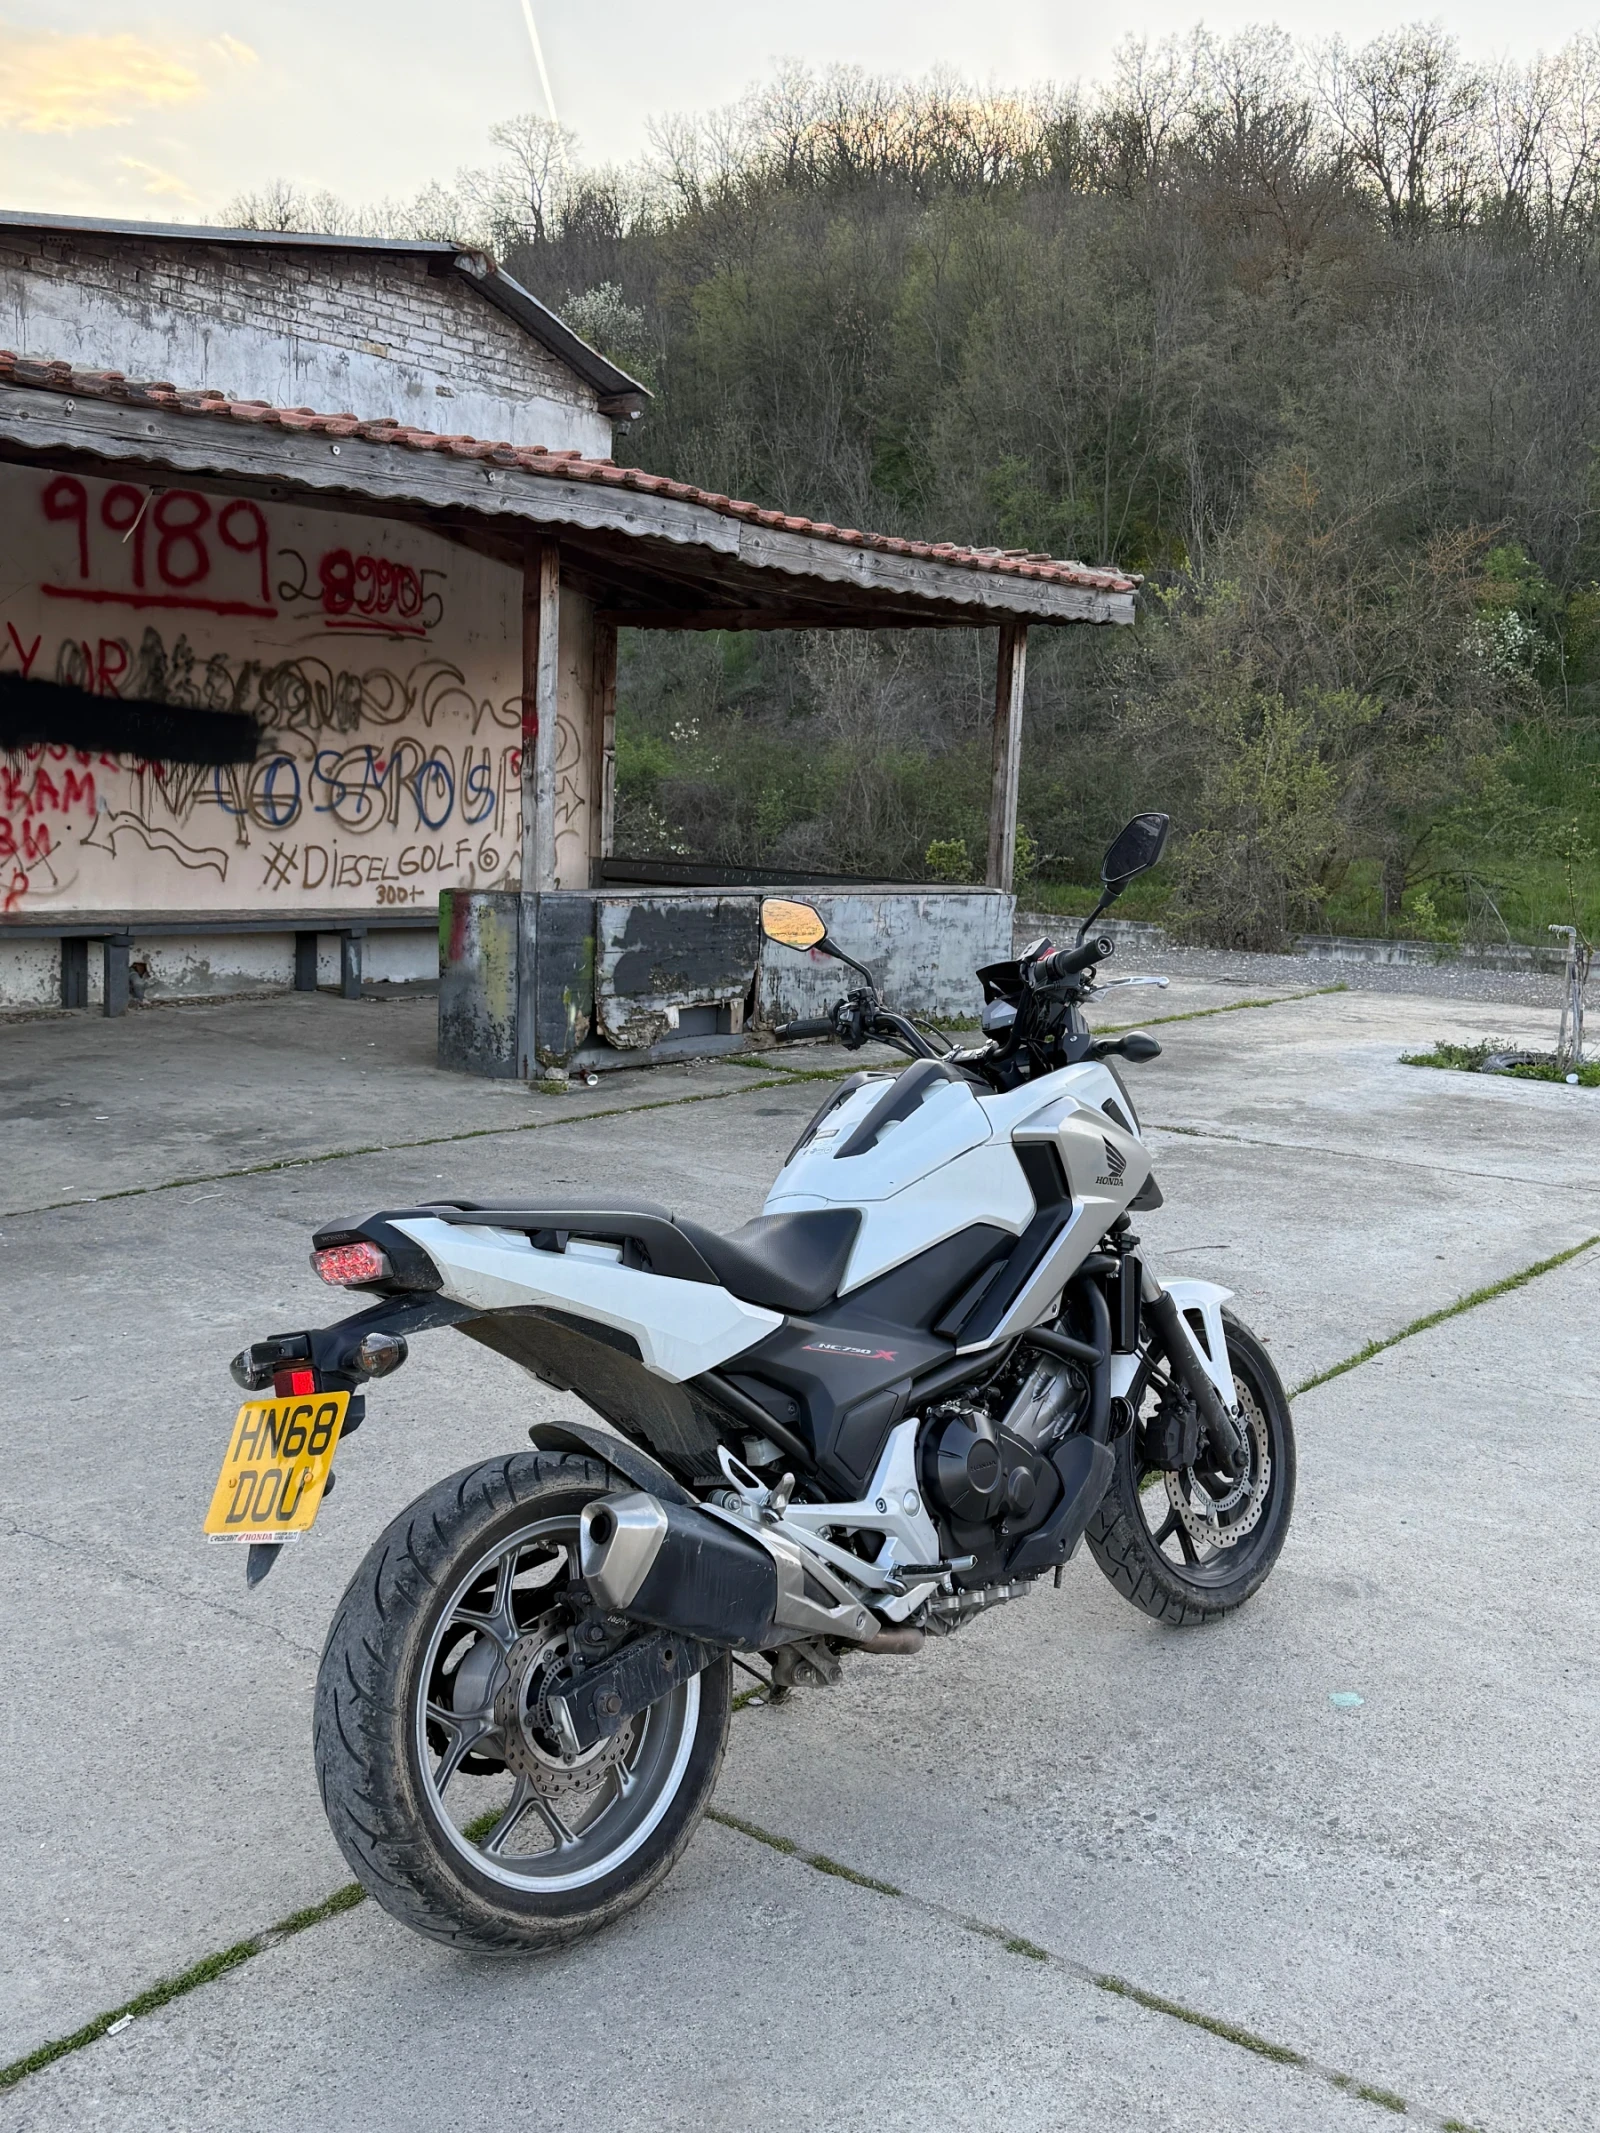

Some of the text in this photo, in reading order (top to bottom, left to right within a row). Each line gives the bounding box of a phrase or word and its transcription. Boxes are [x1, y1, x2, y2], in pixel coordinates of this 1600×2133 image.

[42, 475, 271, 602] 9989
[1095, 1176, 1124, 1187] HONDA
[321, 1233, 350, 1242] HONDA
[233, 1402, 339, 1463] HN68
[225, 1467, 310, 1523] DOU
[245, 1533, 273, 1541] HONDA
